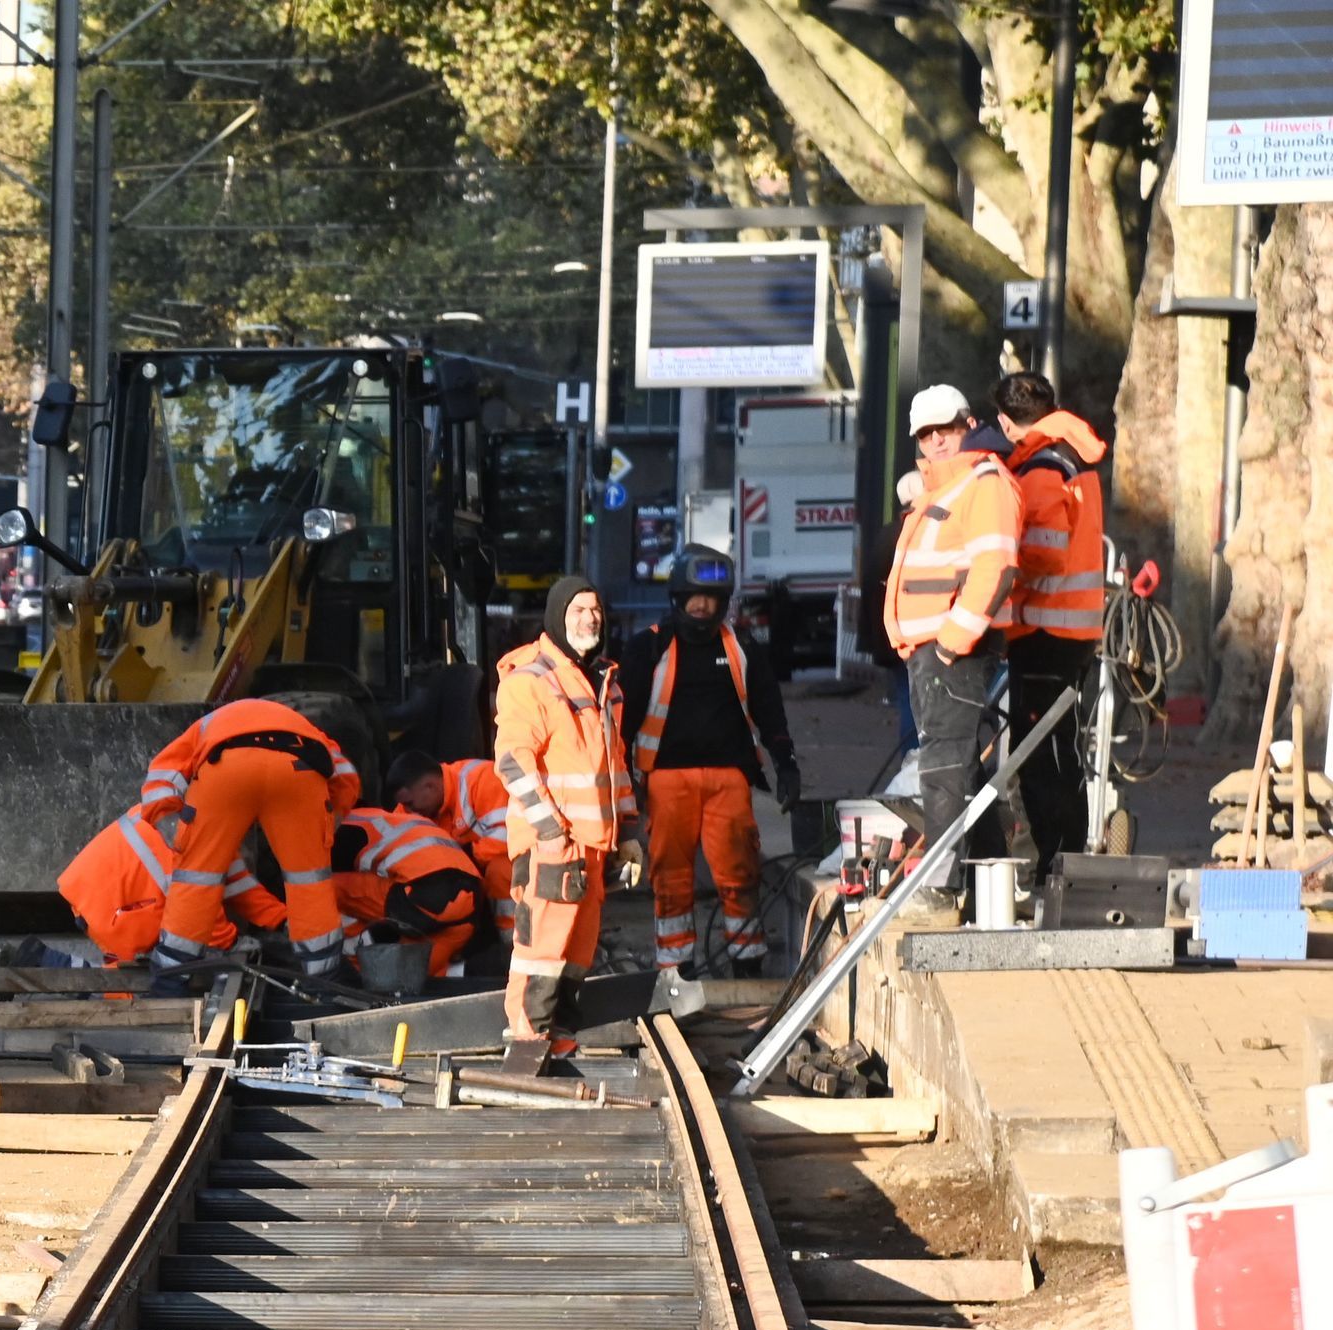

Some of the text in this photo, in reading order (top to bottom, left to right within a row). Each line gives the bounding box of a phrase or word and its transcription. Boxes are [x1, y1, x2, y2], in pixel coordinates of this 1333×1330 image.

[1213, 152, 1241, 166] und
[1247, 152, 1268, 167] (H)
[1273, 151, 1288, 164] Bf
[1212, 166, 1247, 180] Linie
[1265, 165, 1301, 179] fährt
[1009, 296, 1034, 323] 4
[555, 382, 590, 422] H
